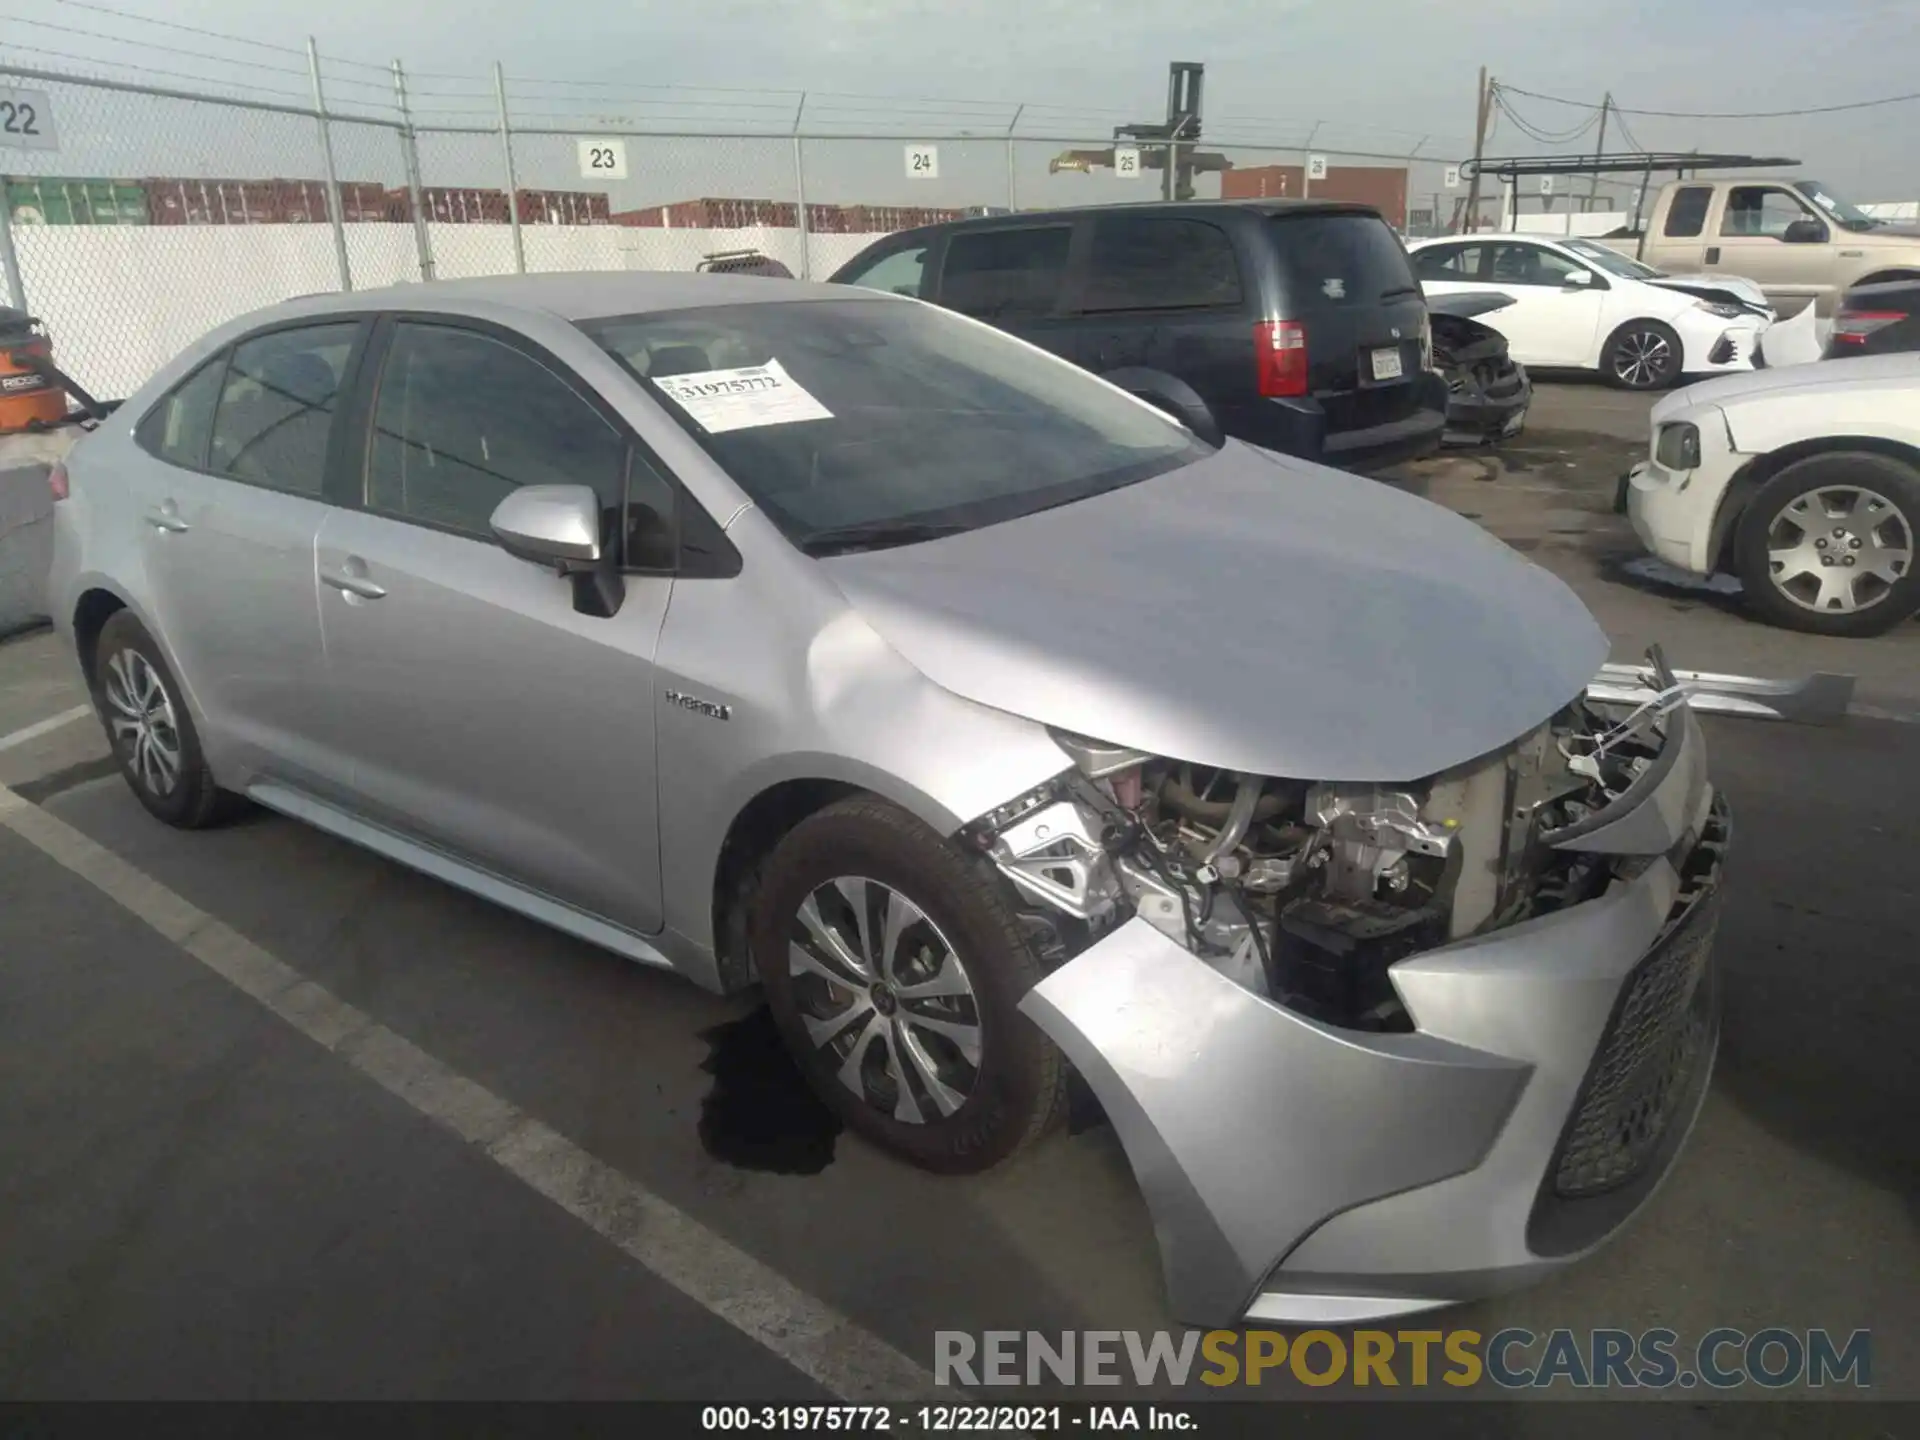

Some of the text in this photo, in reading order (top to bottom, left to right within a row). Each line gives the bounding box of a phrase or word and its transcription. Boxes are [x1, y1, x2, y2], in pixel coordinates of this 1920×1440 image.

[0, 101, 40, 135] 22
[590, 148, 615, 169] 23
[912, 153, 931, 171] 24
[1120, 156, 1134, 171] 25
[680, 376, 782, 398] 31975772
[665, 689, 720, 719] HYBRID
